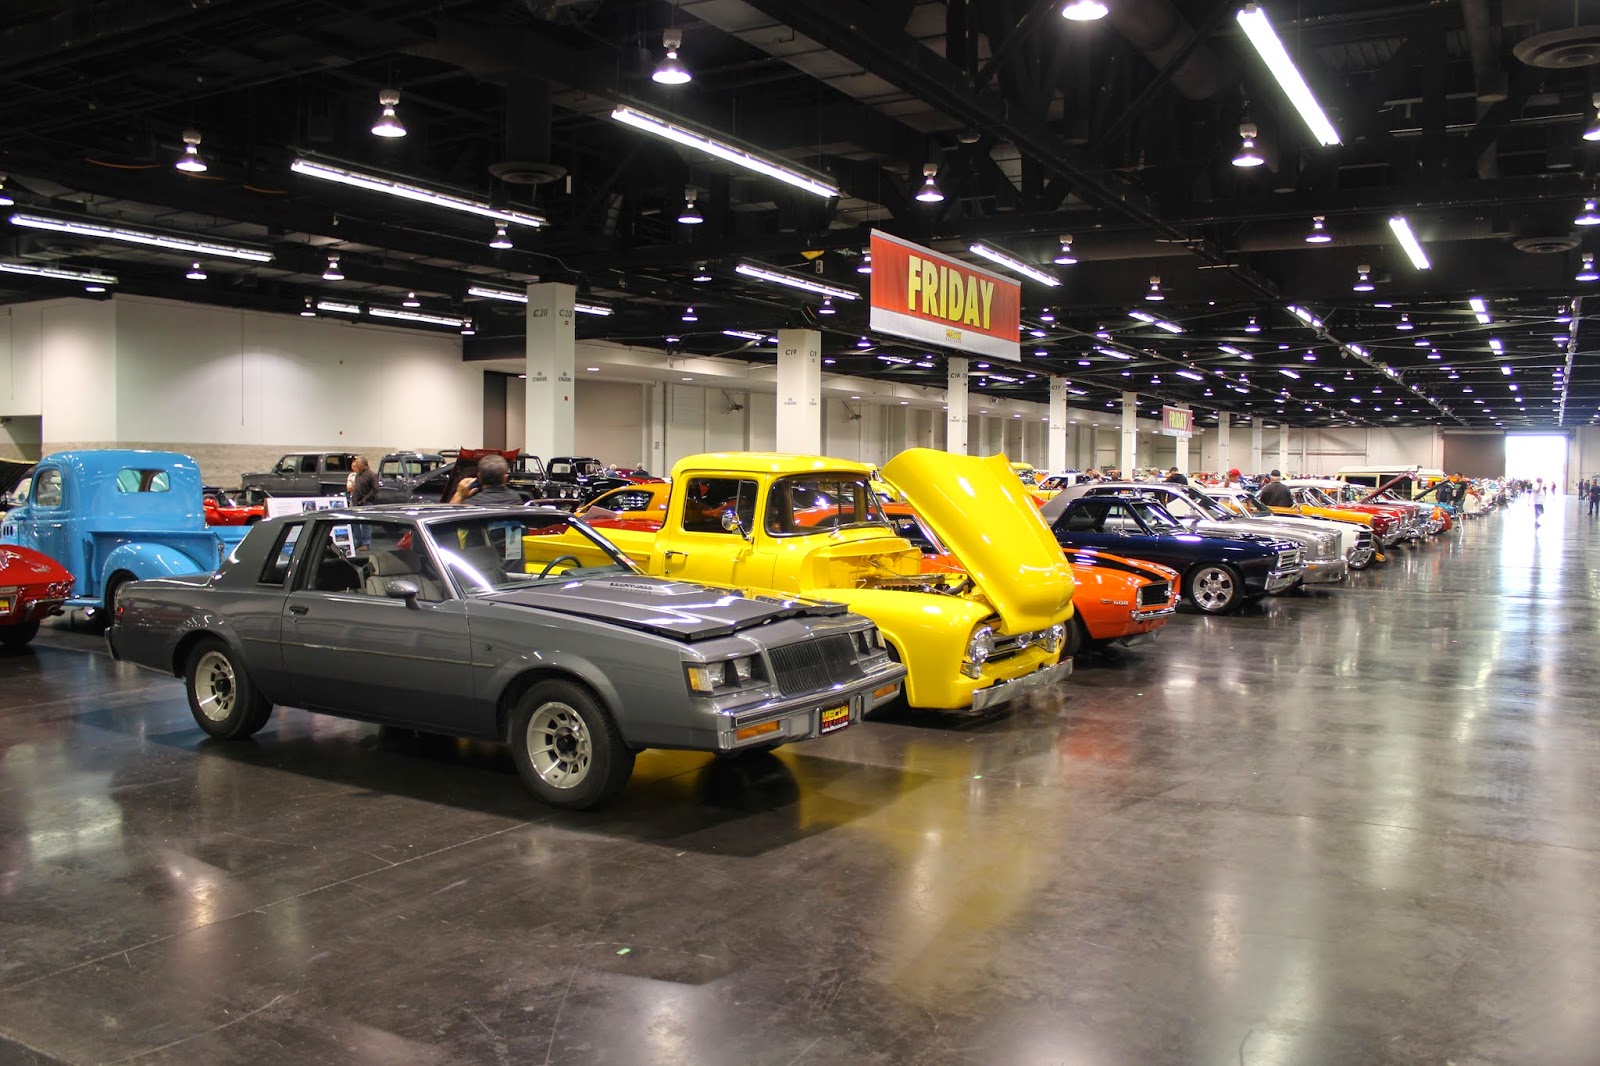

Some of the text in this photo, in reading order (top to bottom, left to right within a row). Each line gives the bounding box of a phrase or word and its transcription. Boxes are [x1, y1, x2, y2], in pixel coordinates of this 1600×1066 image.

[908, 254, 995, 330] FRIDAY
[533, 308, 549, 318] C20
[559, 309, 573, 318] C20
[785, 348, 797, 356] C19
[822, 705, 849, 723] MECUM
